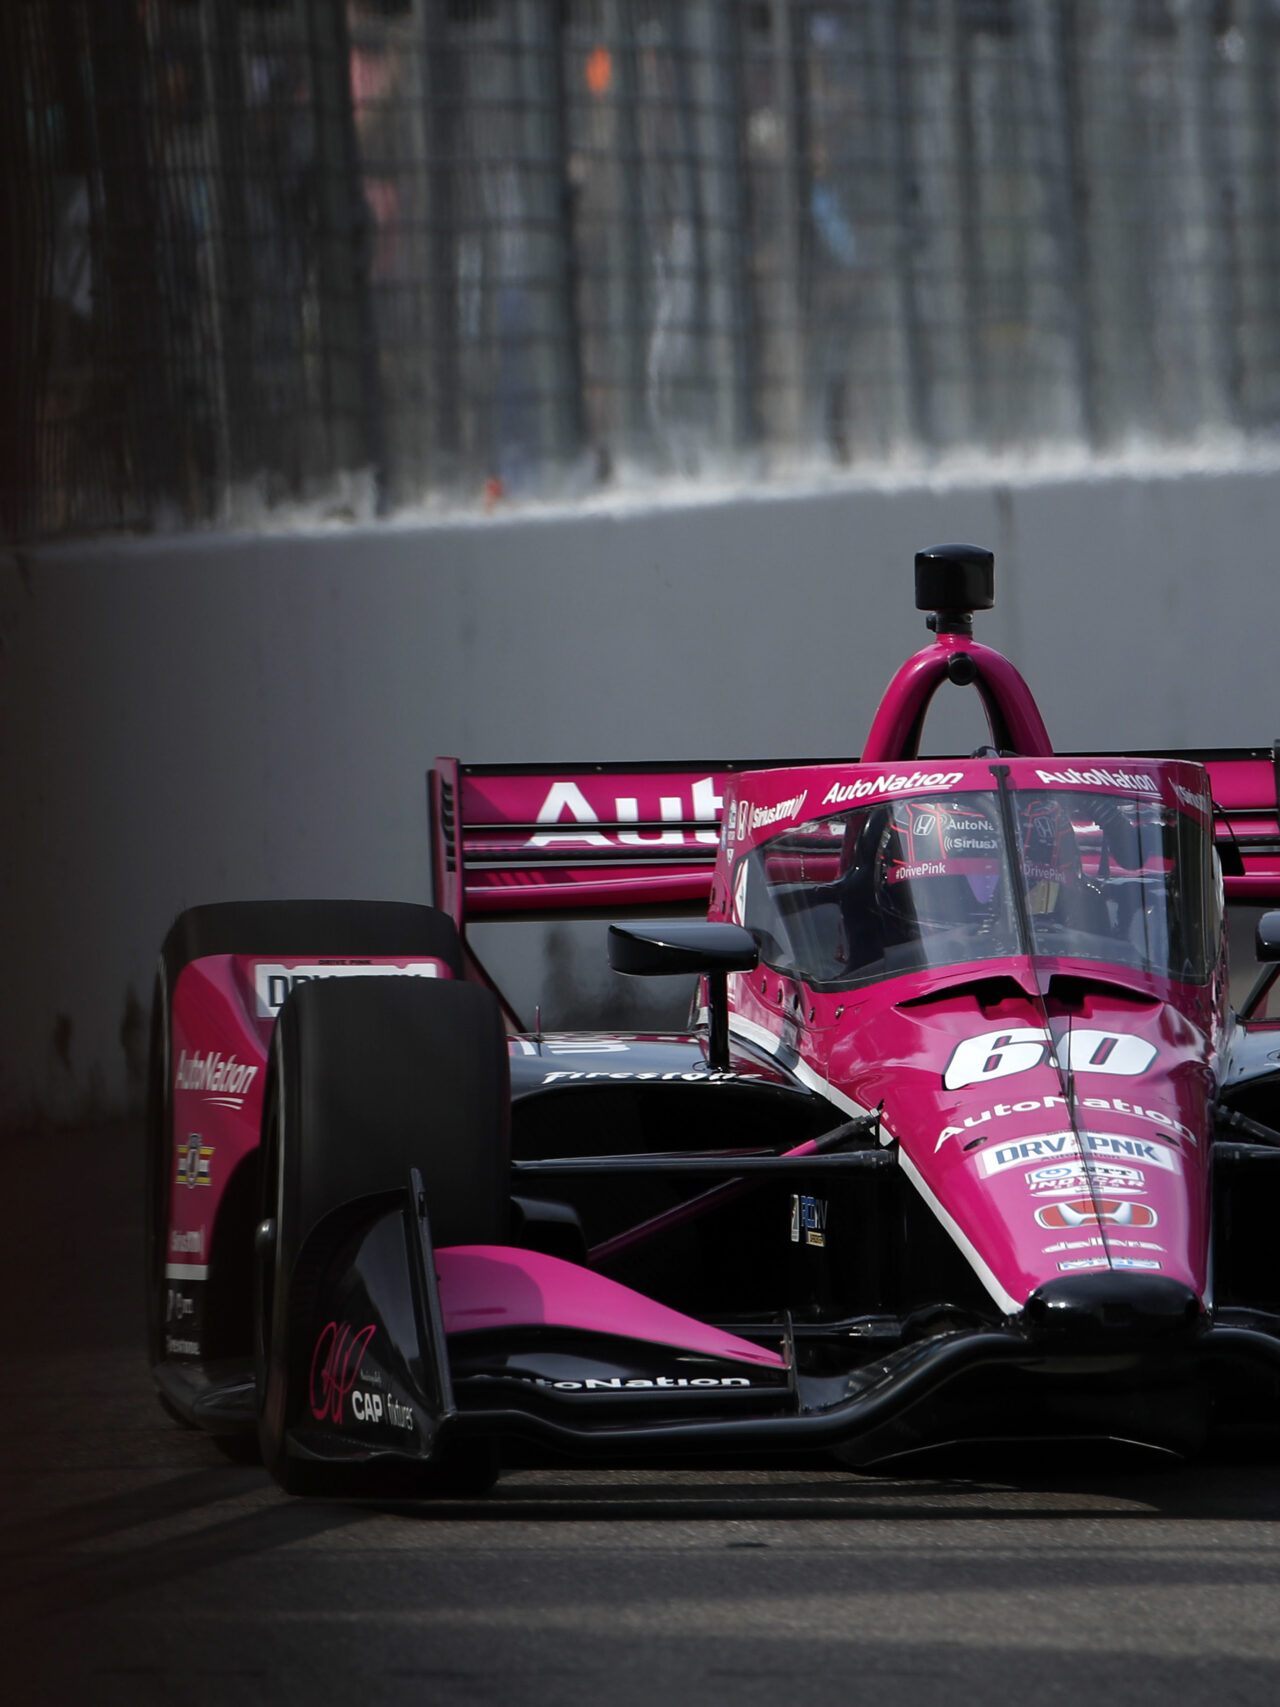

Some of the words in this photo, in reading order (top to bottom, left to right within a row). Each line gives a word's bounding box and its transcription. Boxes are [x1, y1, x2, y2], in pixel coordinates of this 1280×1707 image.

[821, 772, 963, 805] AutoNation
[1035, 768, 1158, 793] AutoNation
[895, 862, 946, 880] #DrivePink
[174, 1048, 259, 1094] AutoNation
[941, 1026, 1159, 1091] 60
[934, 1095, 1198, 1154] AutoNation
[995, 1136, 1067, 1165] DRV
[1086, 1135, 1162, 1162] PNK
[352, 1390, 383, 1423] CAP
